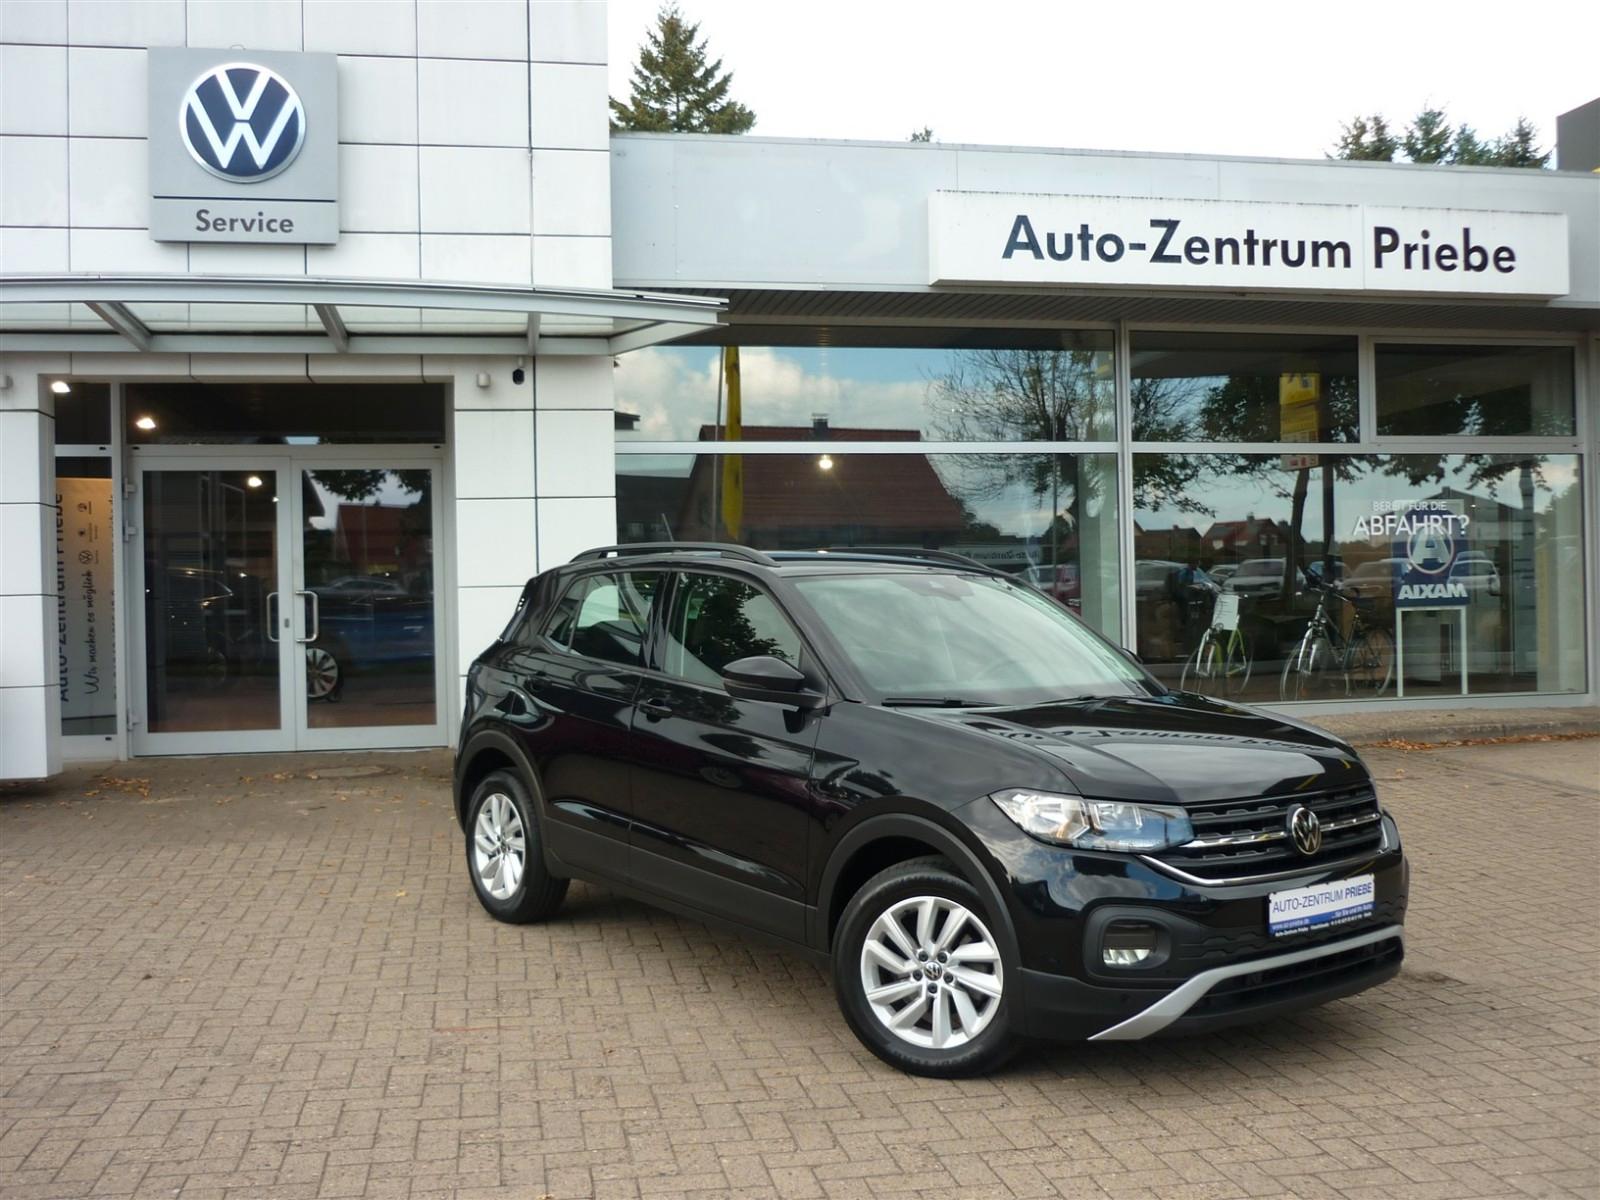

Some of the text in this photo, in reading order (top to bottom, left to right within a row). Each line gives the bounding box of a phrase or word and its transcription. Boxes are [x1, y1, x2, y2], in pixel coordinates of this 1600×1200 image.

[195, 208, 294, 233] Service
[1001, 214, 1516, 274] Auto-Zentrum Priebe
[1353, 514, 1470, 536] ABFAHRT?
[1398, 583, 1468, 600] AIXAM
[83, 665, 100, 695] Wir
[1272, 890, 1343, 913] AUTO-ZENTRUM
[1345, 882, 1372, 899] PRIEBE
